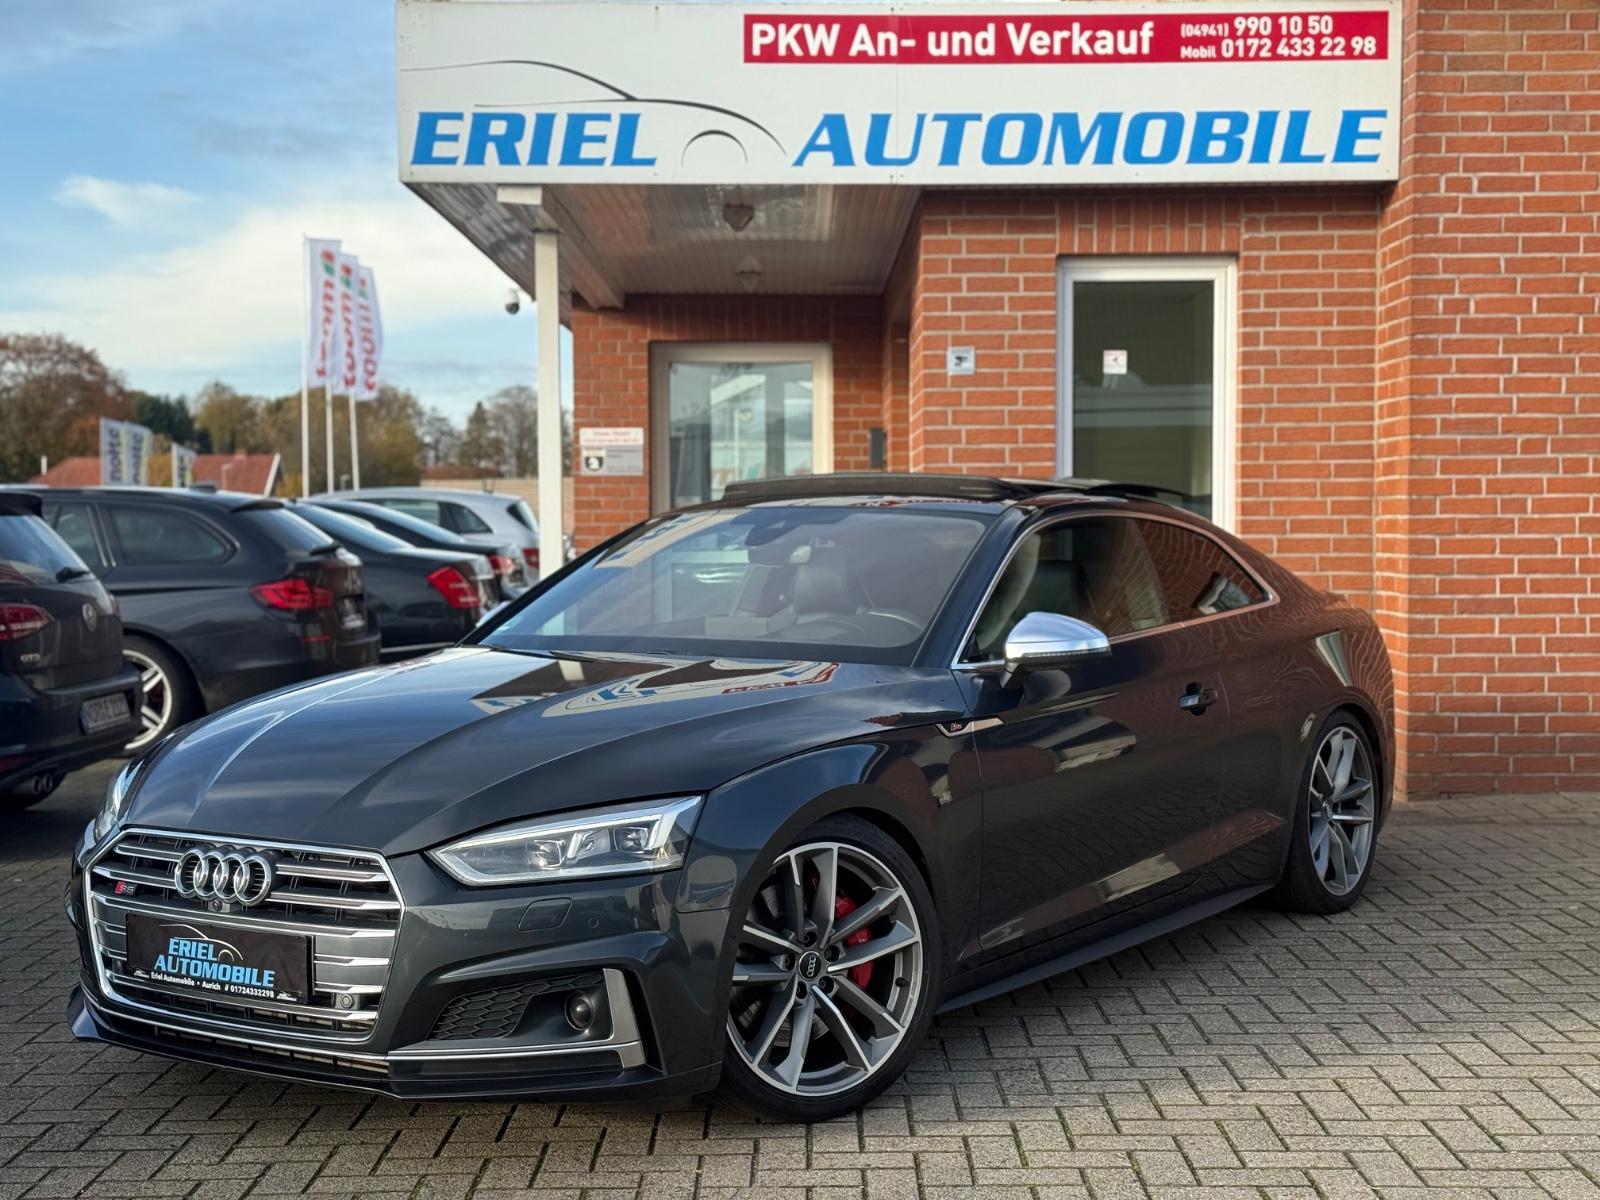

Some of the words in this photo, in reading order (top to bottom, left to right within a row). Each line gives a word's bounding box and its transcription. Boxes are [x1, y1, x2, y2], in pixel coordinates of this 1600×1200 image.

[751, 23, 841, 57] PKW
[849, 22, 916, 56] An-
[928, 23, 995, 57] und
[1006, 21, 1154, 56] Verkauf
[1180, 22, 1229, 38] (04941)
[1234, 16, 1272, 36] 990
[1279, 16, 1302, 35] 10
[1308, 15, 1333, 35] 50
[1180, 46, 1216, 59] Mobil
[1221, 38, 1272, 58] 0172
[1276, 38, 1315, 57] 433
[1320, 37, 1346, 56] 22
[1351, 36, 1377, 56] 98
[410, 112, 657, 166] ERIEL
[791, 109, 1388, 167] AUTOMOBILE
[168, 938, 217, 961] ERIEL
[154, 954, 275, 987] AUTOMOBILE
[150, 971, 163, 981] Eriel
[163, 973, 195, 986] Automobile
[202, 981, 221, 991] Aurich
[230, 985, 274, 998] 01724332298
